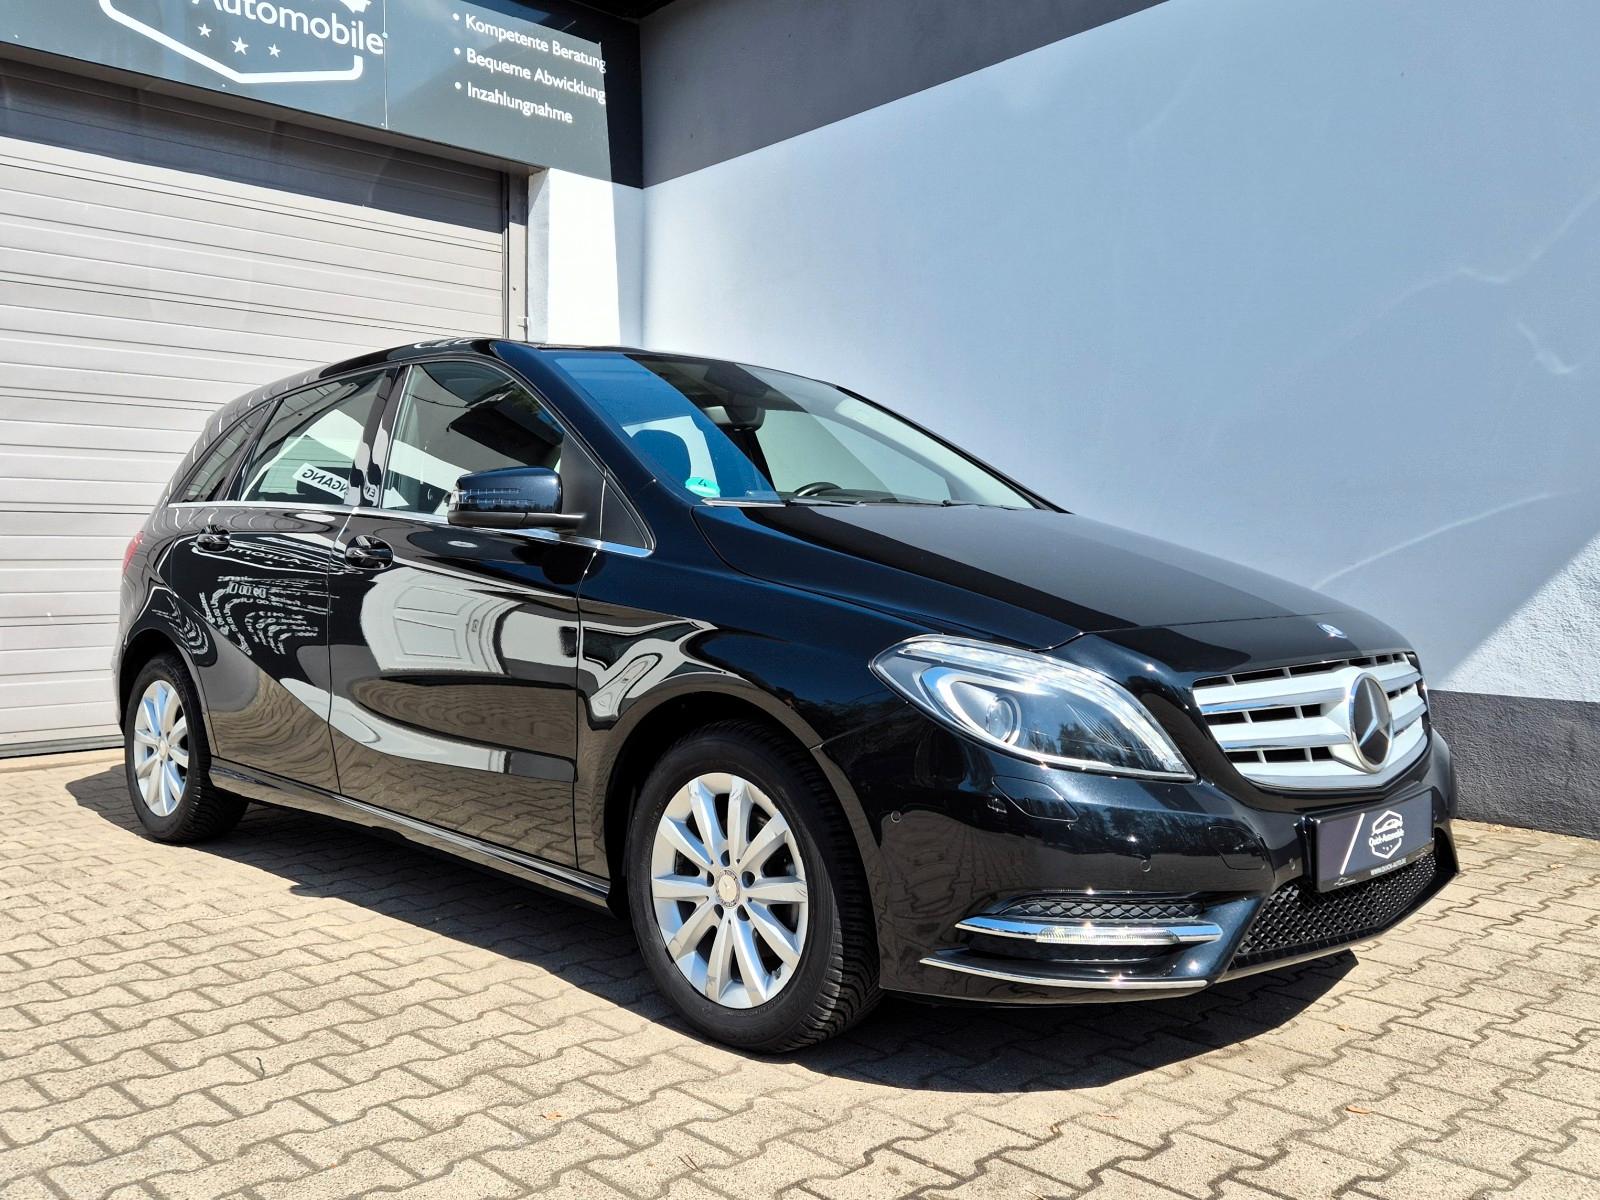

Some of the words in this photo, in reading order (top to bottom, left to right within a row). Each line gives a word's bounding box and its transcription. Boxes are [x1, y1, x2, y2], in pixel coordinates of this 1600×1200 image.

[465, 13, 549, 52] Kompetente
[552, 40, 607, 74] Beratung
[466, 47, 532, 80] Bequeme
[534, 68, 606, 105] Abwicklung
[467, 81, 573, 123] Inzahlungnahme
[698, 478, 707, 487] 4
